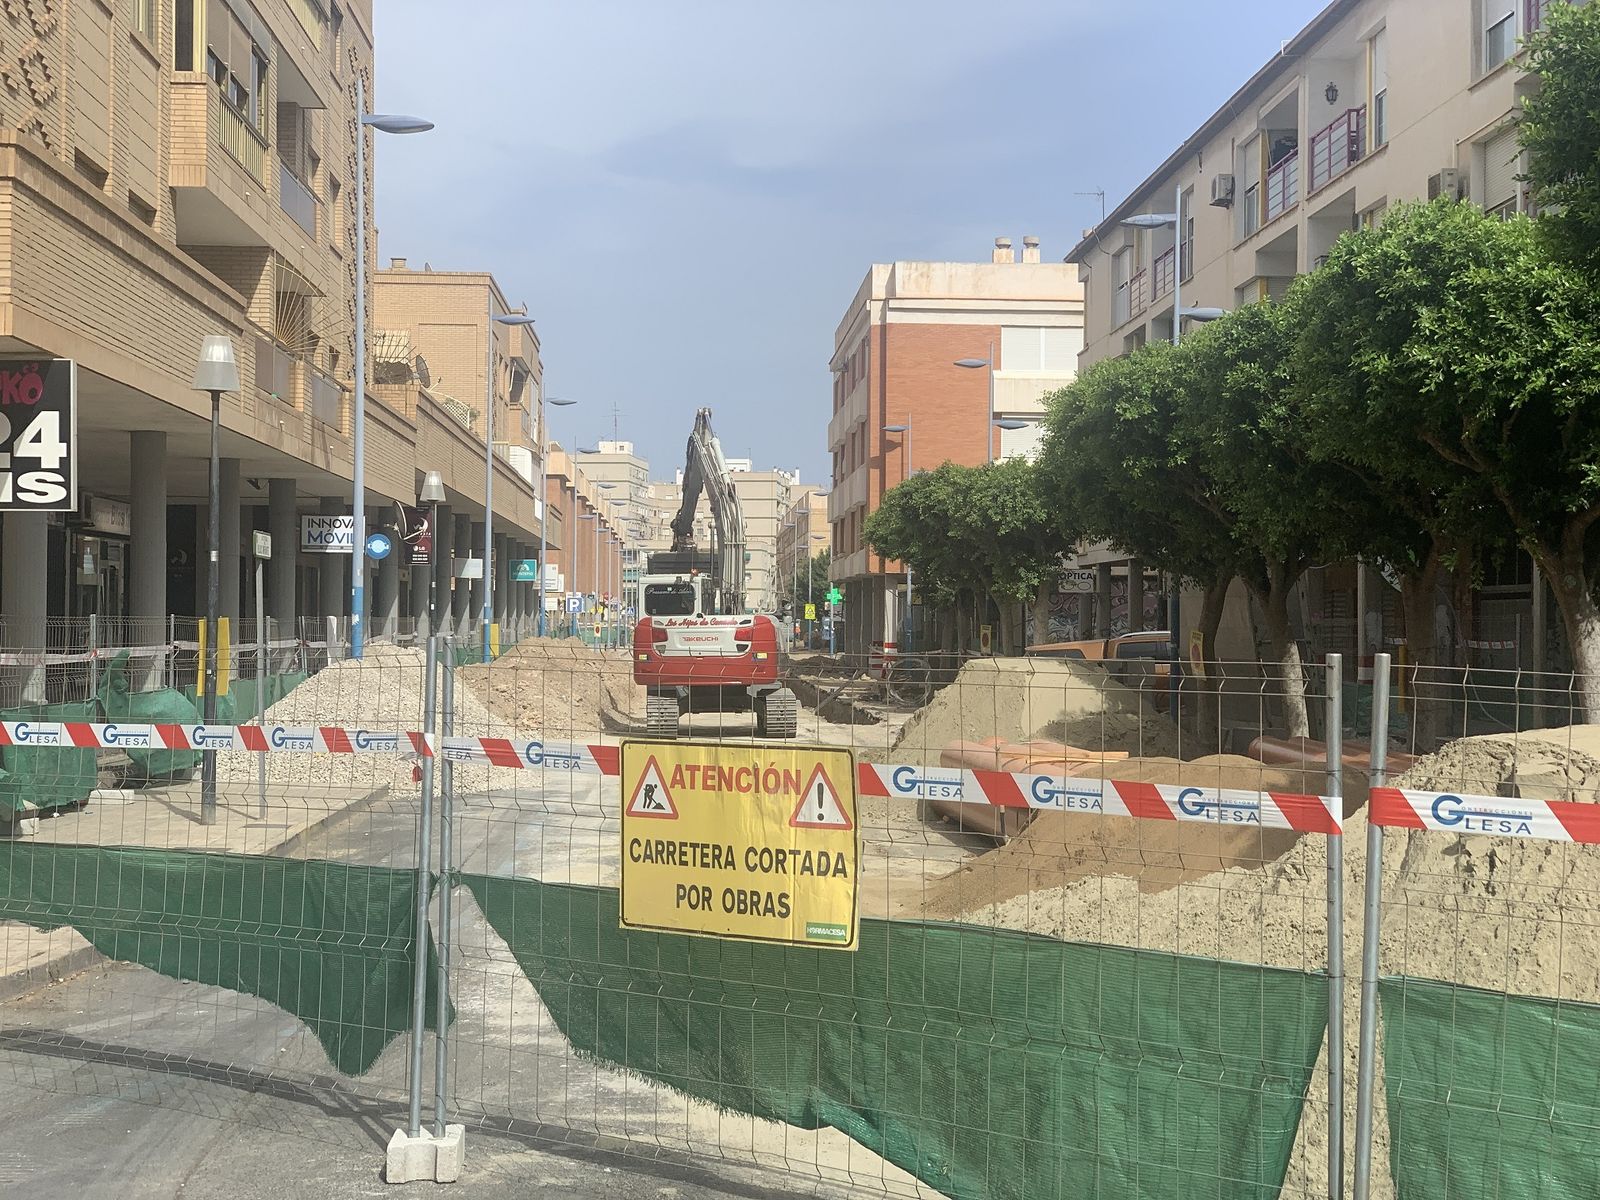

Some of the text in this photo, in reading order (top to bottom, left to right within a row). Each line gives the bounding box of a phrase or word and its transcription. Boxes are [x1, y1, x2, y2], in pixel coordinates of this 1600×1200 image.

[307, 518, 353, 529] INNOV
[569, 598, 580, 612] P
[15, 722, 59, 744] GLESA
[103, 724, 149, 746] GLESA
[193, 725, 232, 748] GLESA
[271, 726, 313, 750] GLESA
[356, 730, 399, 751] GLESA
[525, 742, 581, 770] GLESA
[669, 761, 802, 796] ATENCIÓN
[892, 766, 964, 798] GLESA
[1031, 775, 1102, 810] GLESA
[1178, 788, 1260, 823] GLESA
[1431, 795, 1532, 835] GLESA
[629, 837, 848, 878] CARRETERA CORTADA
[676, 883, 791, 918] POR OBRAS
